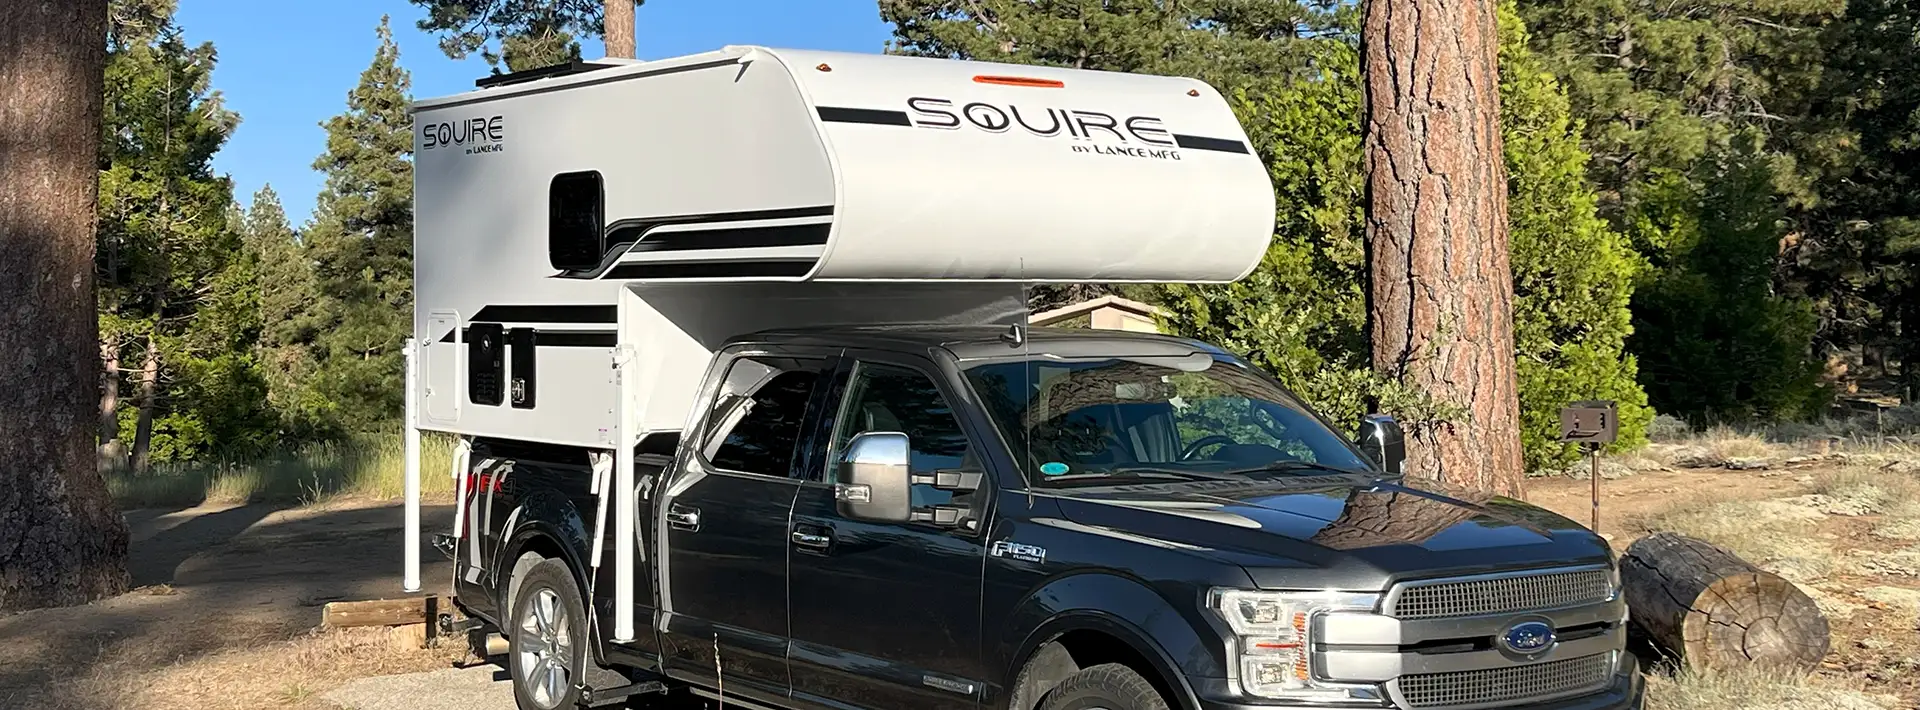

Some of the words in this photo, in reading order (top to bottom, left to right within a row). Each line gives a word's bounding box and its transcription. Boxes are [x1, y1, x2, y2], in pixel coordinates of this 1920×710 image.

[423, 115, 503, 151] SQUIRE
[907, 97, 1174, 147] SQUIRE
[473, 145, 491, 154] LANCE
[1071, 145, 1091, 153] BY
[1093, 144, 1148, 158] LANCE
[1148, 148, 1181, 160] MFG
